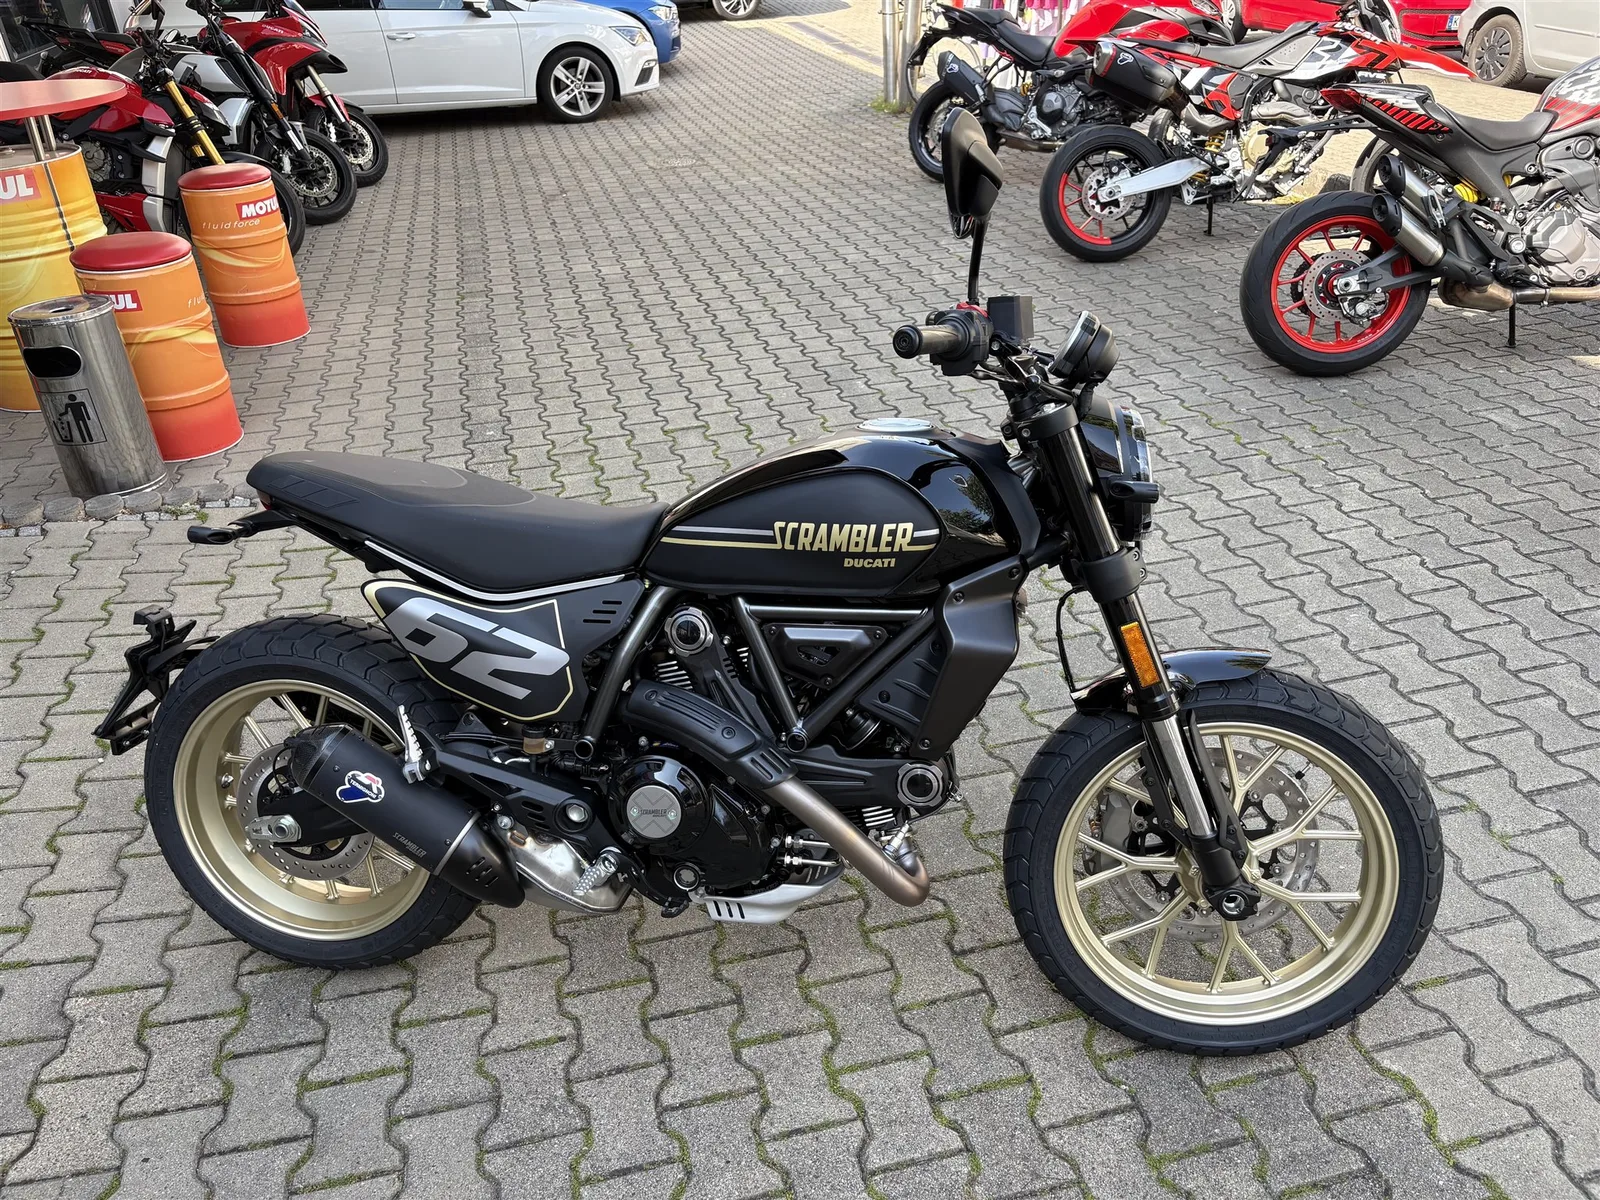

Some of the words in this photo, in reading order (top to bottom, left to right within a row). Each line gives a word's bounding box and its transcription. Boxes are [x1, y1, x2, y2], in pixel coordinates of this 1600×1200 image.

[0, 173, 34, 200] UL
[241, 196, 279, 218] MOTU
[233, 218, 260, 229] force
[111, 294, 138, 310] UL
[773, 521, 914, 552] SCRAMBLER
[843, 558, 896, 568] DUCATI
[383, 597, 570, 700] 62
[392, 832, 427, 858] SCRAMBLER
